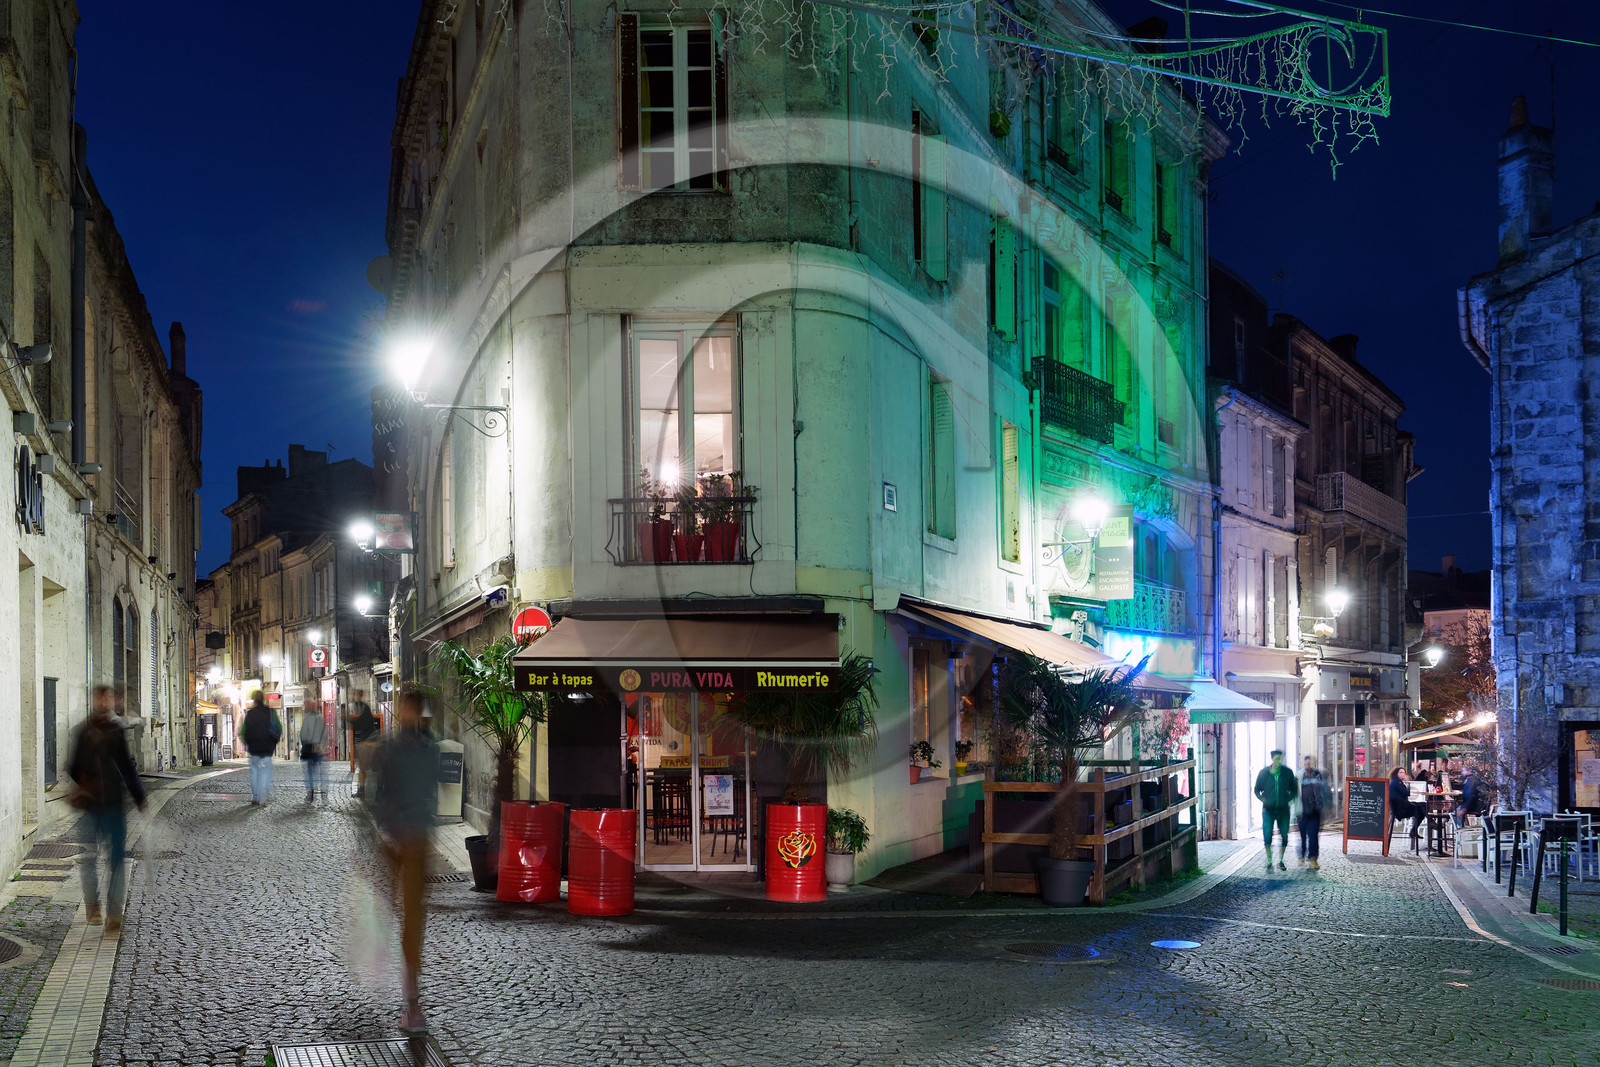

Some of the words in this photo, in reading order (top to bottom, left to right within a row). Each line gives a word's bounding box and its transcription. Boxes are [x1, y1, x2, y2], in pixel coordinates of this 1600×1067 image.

[374, 417, 404, 435] SAMI
[1099, 583, 1129, 591] GALERISTE
[528, 673, 549, 686] Bar
[552, 672, 559, 686] à
[562, 673, 593, 688] tapas
[650, 672, 692, 688] PURA
[695, 672, 734, 688] VIDA
[757, 671, 829, 687] Rhumerie
[664, 758, 692, 768] TAPAS
[700, 758, 728, 768] RHUMS
